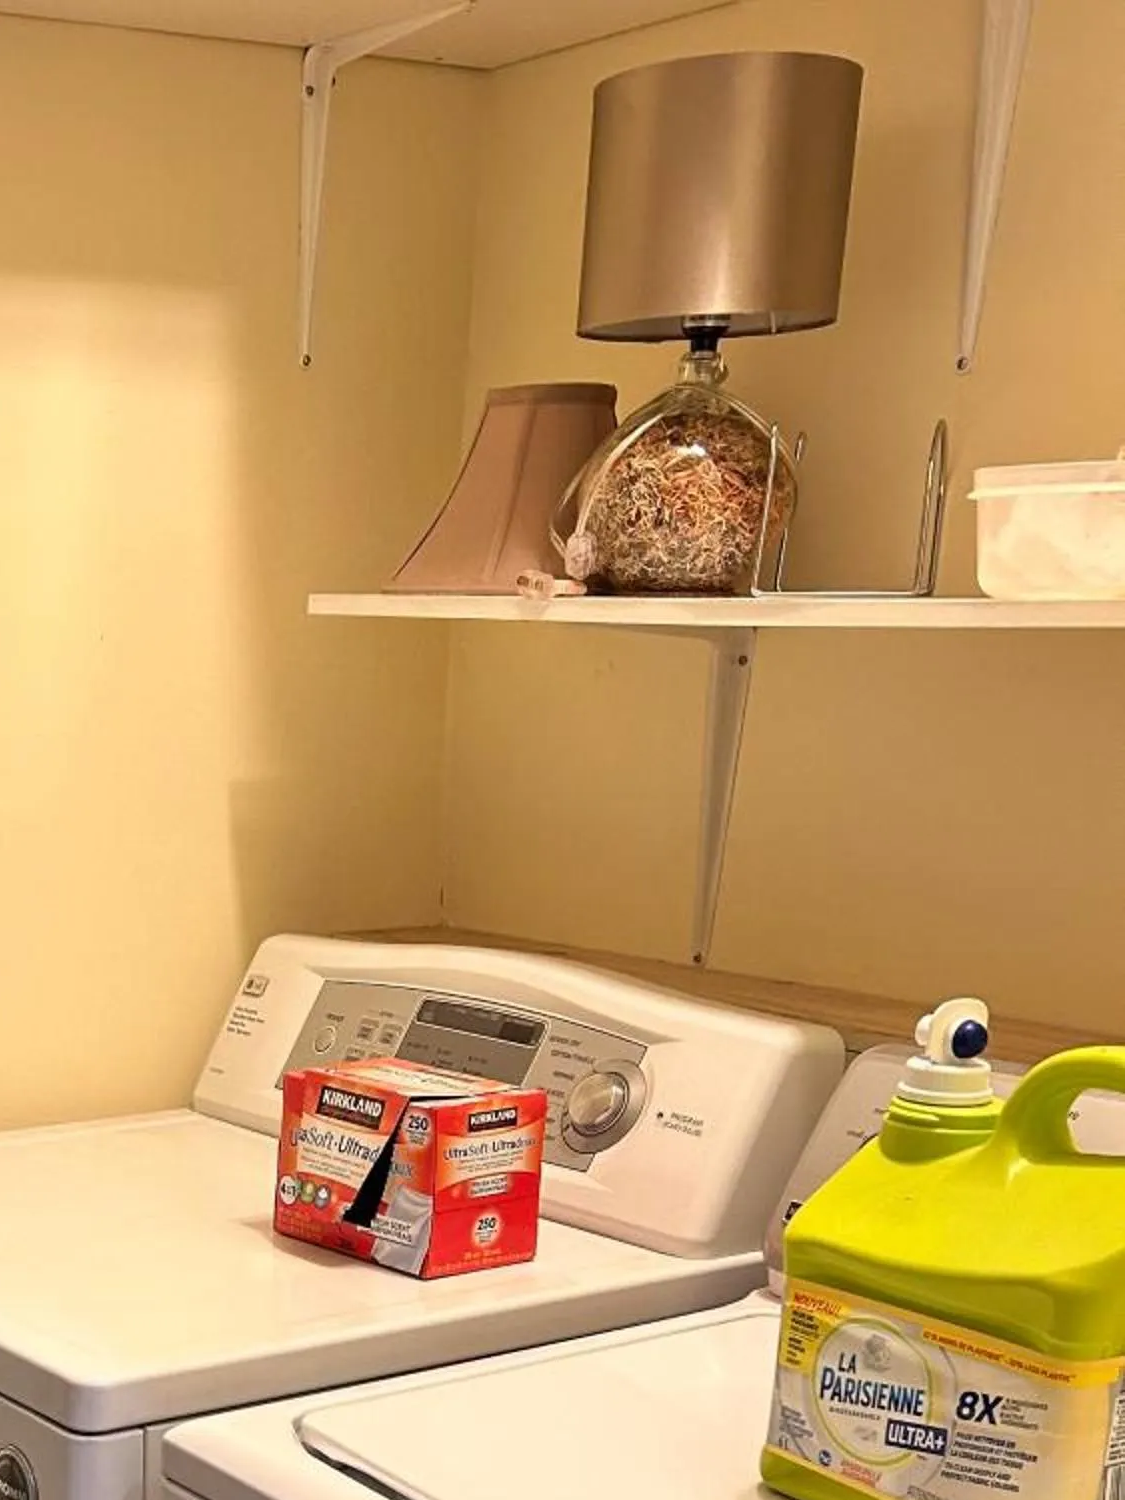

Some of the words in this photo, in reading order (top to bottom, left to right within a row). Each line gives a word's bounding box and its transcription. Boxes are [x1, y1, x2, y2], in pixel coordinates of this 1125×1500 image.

[322, 1089, 382, 1116] KIRKLAND
[408, 1114, 428, 1131] 250
[470, 1109, 516, 1126] KIRKLAND
[838, 1352, 857, 1374] LA
[820, 1367, 926, 1417] PARISIENNE
[956, 1391, 1004, 1425] 8X
[888, 1423, 944, 1450] ULTRA+
